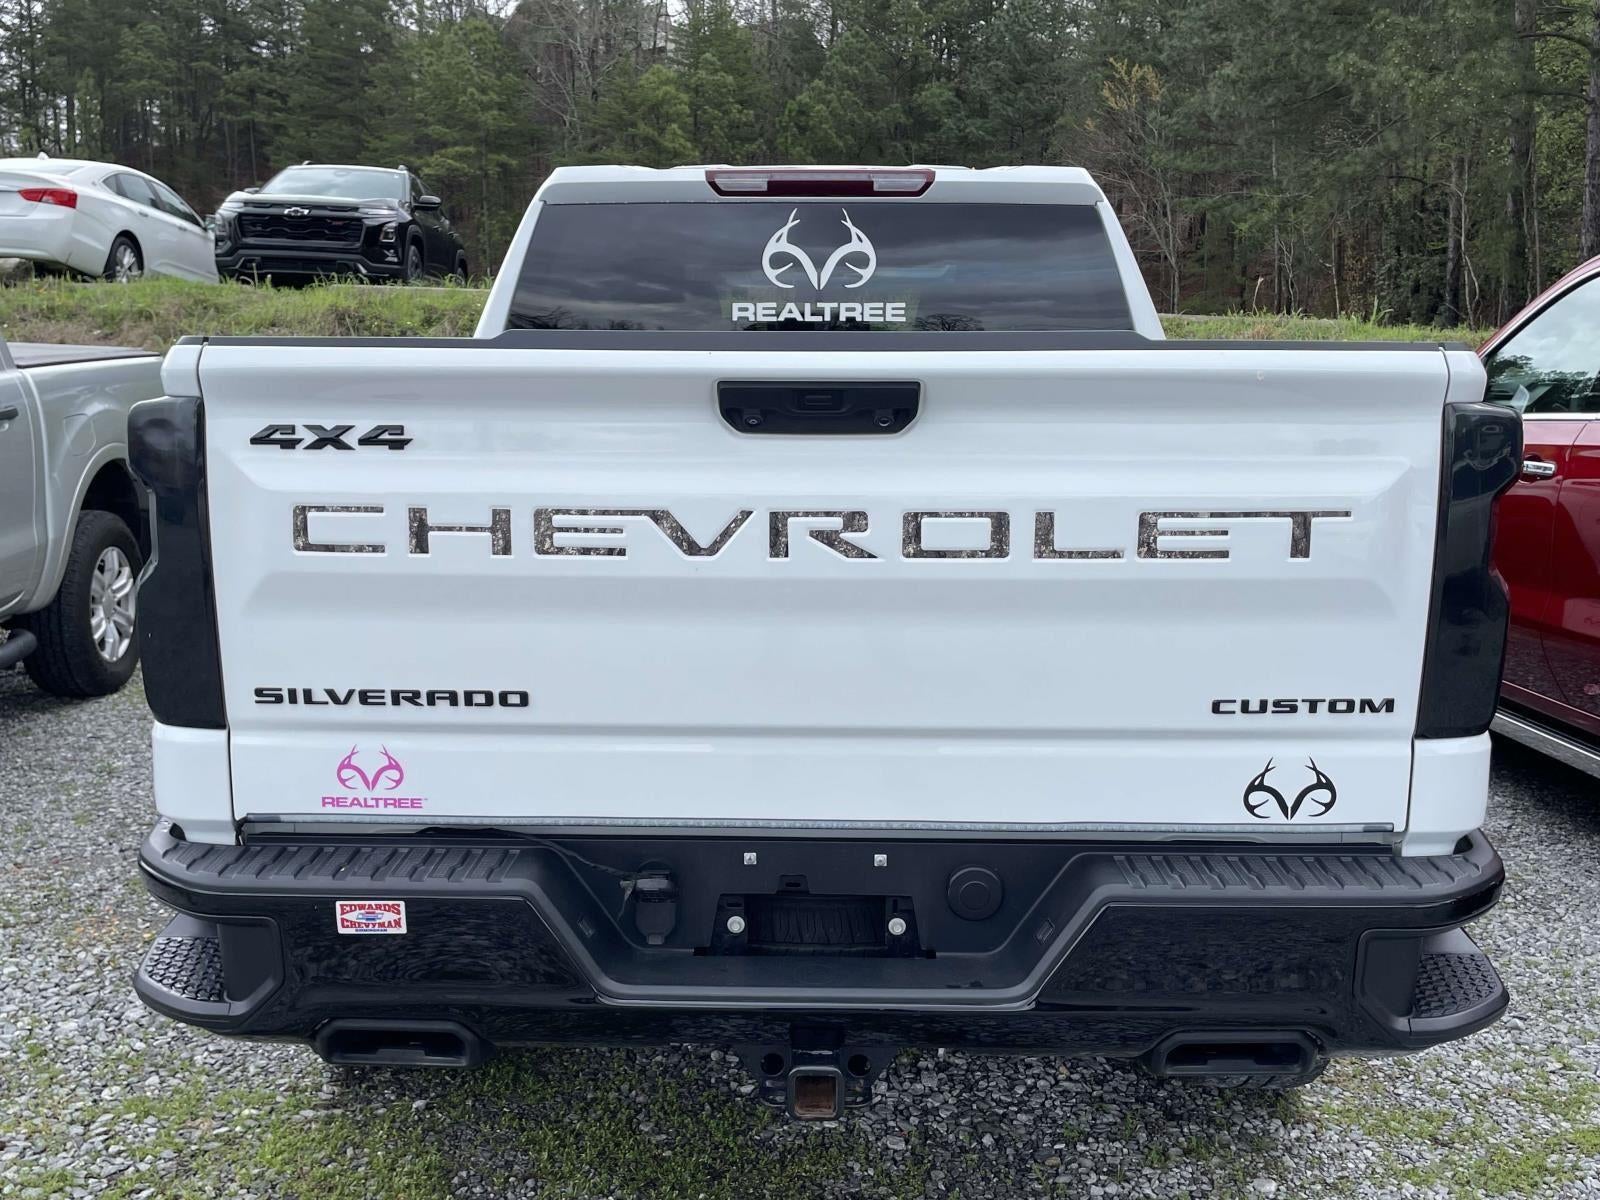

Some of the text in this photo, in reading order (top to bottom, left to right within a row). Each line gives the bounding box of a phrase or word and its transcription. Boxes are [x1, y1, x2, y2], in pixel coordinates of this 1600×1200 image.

[732, 302, 907, 322] REALTREE
[292, 504, 1352, 560] CHEVROLET
[253, 687, 530, 708] SILVERADO
[1211, 697, 1395, 715] CUSTOM
[321, 796, 423, 809] REALTREE
[339, 903, 401, 916] EDWARDS
[340, 917, 402, 929] CHEVYMAN
